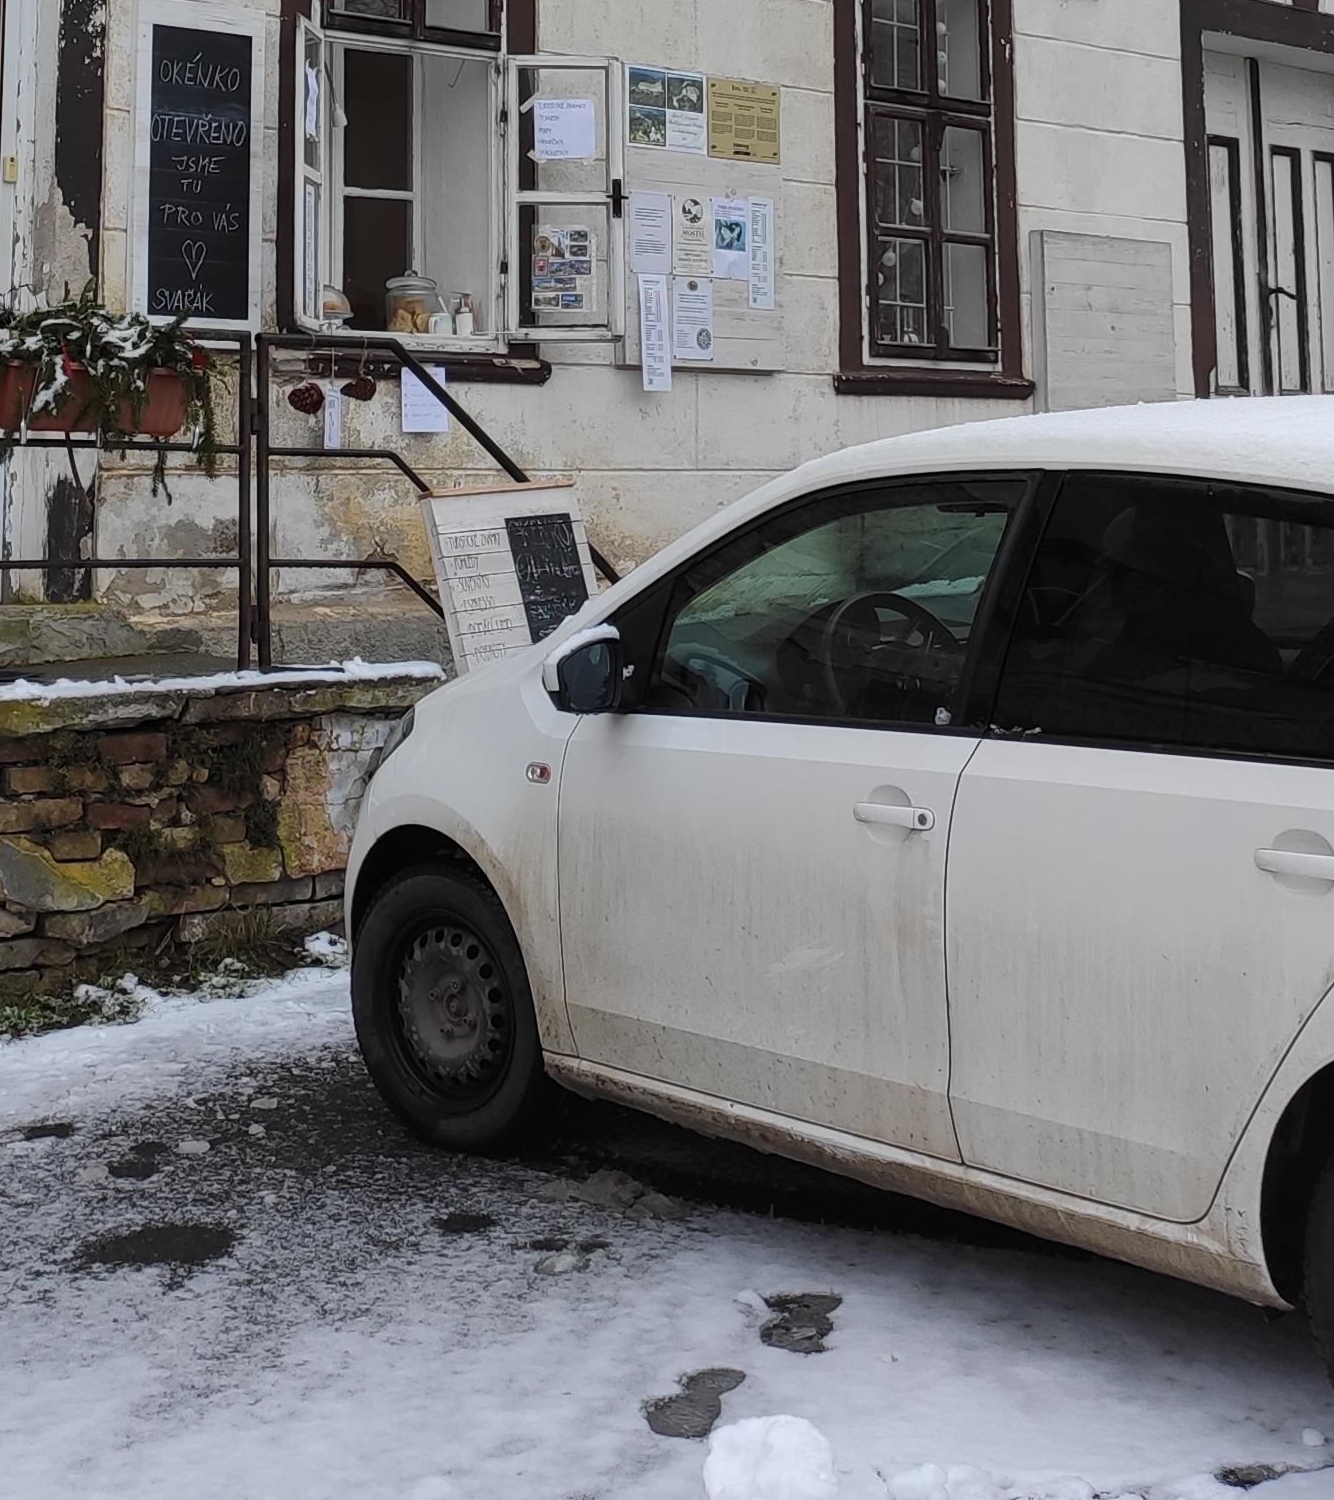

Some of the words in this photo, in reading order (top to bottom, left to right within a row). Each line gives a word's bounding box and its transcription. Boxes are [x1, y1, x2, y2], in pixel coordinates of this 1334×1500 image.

[159, 52, 241, 92] OKÉNKO
[150, 112, 247, 148] OTEVŘENO
[171, 155, 227, 176] JSME
[180, 179, 202, 194] TU
[159, 203, 203, 228] PRO
[211, 203, 240, 234] VÁS
[152, 284, 215, 314] SVAŘÁK
